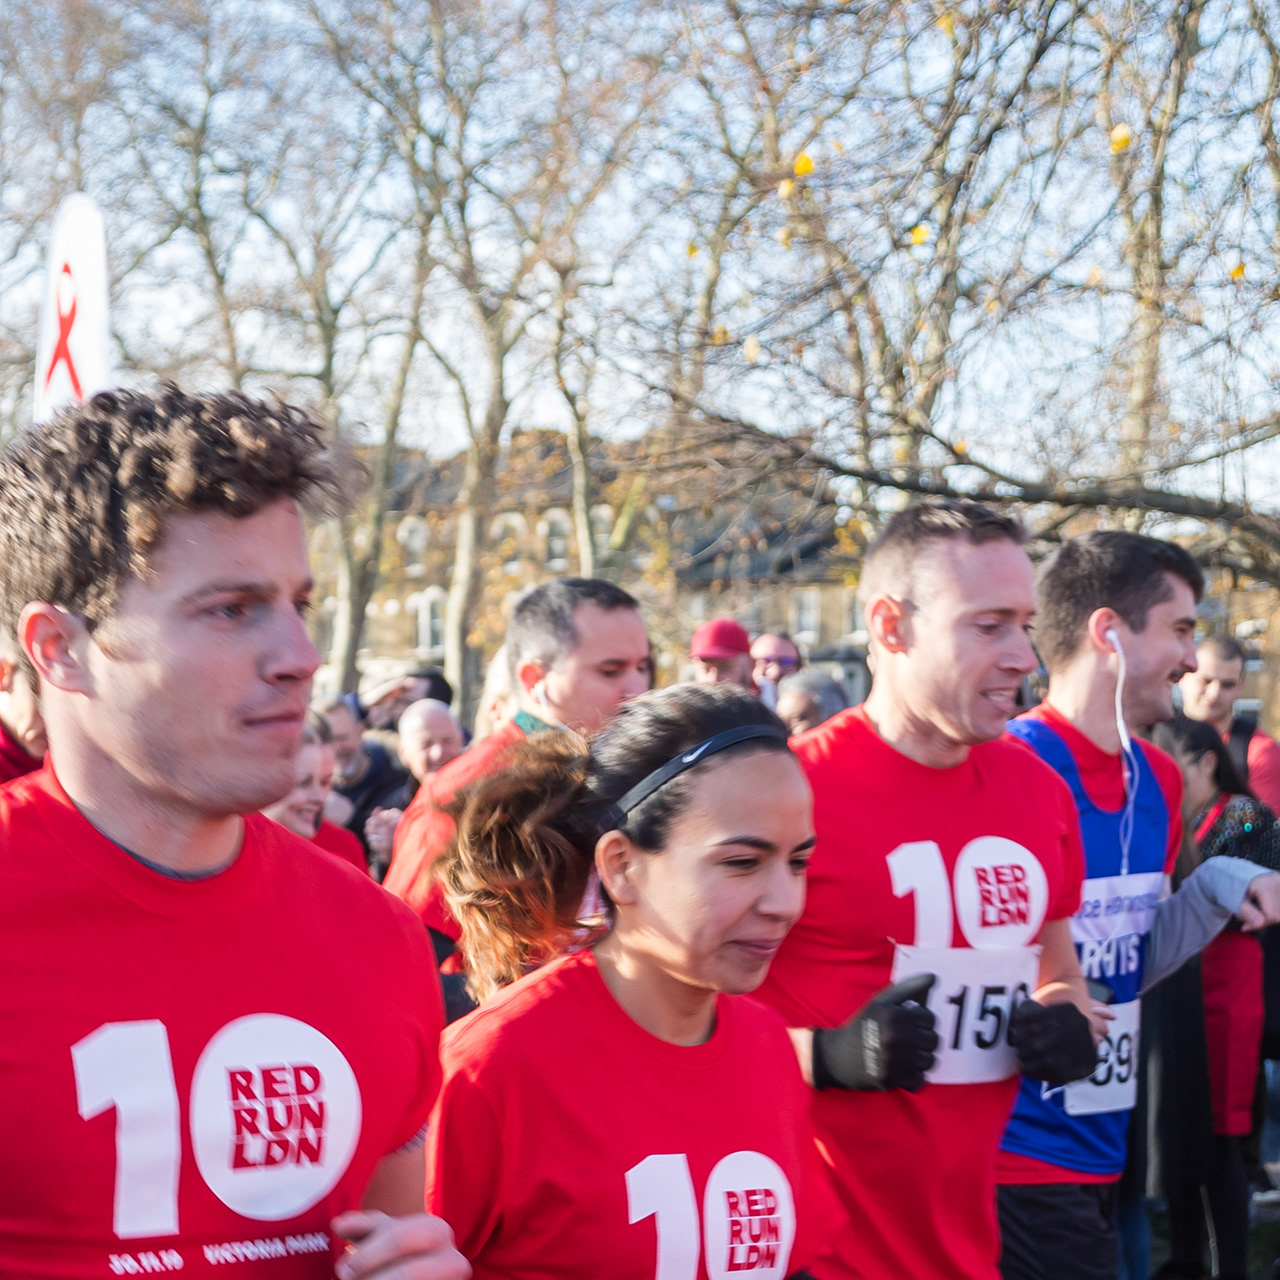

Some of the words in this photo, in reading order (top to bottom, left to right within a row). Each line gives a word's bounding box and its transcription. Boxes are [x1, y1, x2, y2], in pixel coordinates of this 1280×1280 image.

[885, 835, 1049, 949] 10
[976, 864, 1026, 886] RED
[980, 883, 1029, 905] RUN
[226, 1062, 324, 1102] RED
[71, 1012, 363, 1239] 10
[231, 1098, 326, 1137] RUN
[229, 1134, 325, 1172] LDN
[724, 1188, 777, 1218] RED
[727, 1217, 779, 1245] RUN
[726, 1244, 777, 1272] LDN
